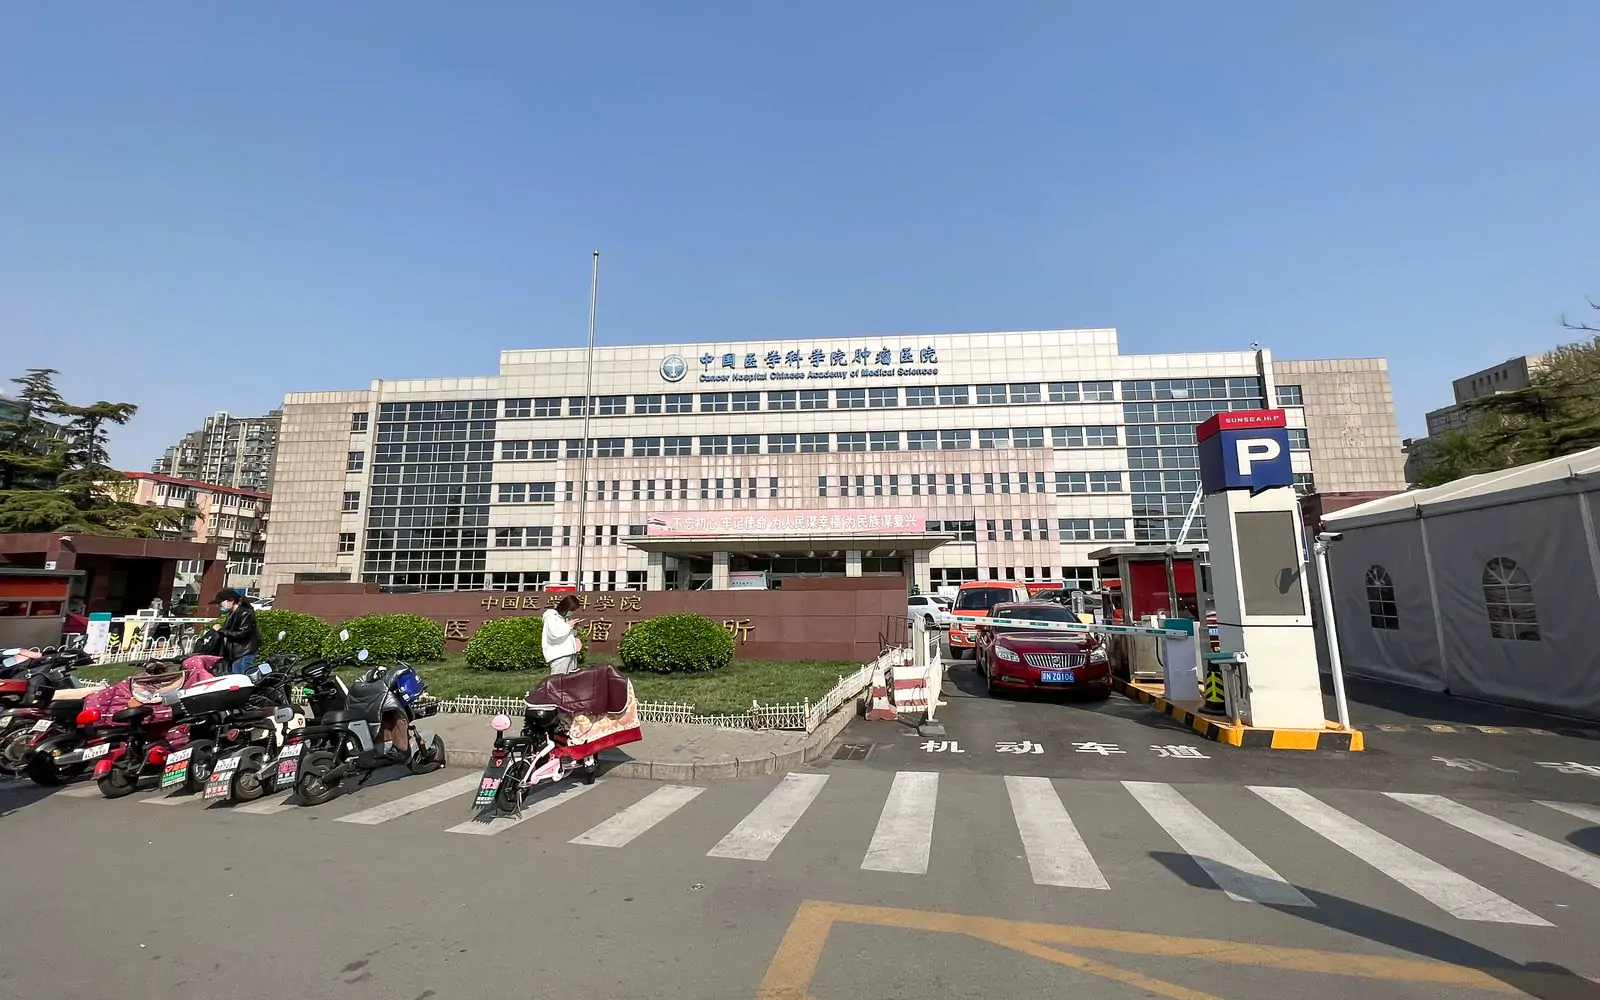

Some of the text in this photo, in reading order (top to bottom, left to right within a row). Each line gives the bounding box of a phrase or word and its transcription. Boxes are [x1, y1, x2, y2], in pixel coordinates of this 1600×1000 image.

[699, 346, 938, 372] 中国医学科学院肿瘤医院
[700, 367, 938, 382] Cancer Hospital Chinese Academy of Medical Sciences
[1236, 438, 1281, 476] P
[672, 513, 917, 531] 不忘初心 牢记使命 为人民谋幸福 为民族谋复兴
[920, 740, 1211, 759] 机动车道
